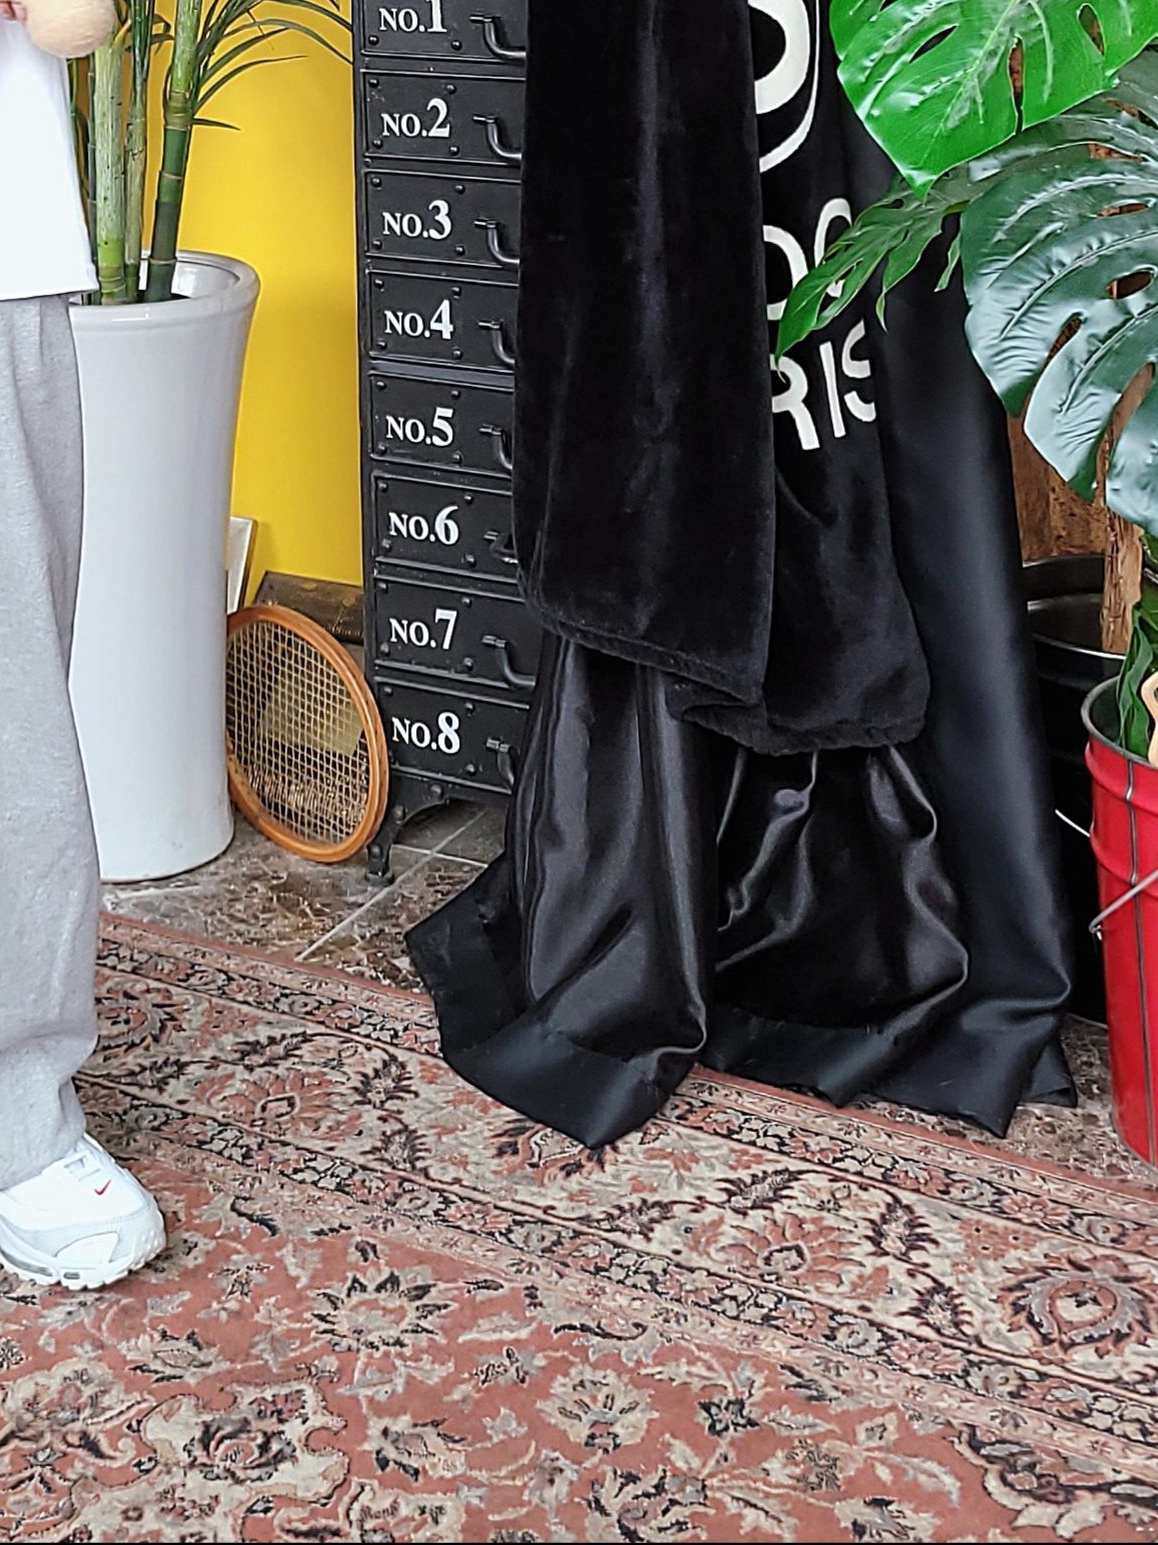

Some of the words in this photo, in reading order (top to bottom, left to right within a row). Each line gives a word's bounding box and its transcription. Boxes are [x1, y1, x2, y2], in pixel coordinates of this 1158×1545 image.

[381, 97, 451, 138] NO.2
[382, 199, 453, 240] NO.3
[383, 299, 454, 340] NO.4
[385, 407, 454, 447] NO.5
[388, 504, 460, 545] NO.6
[389, 608, 458, 650] NO.7
[391, 711, 461, 754] NO.8
